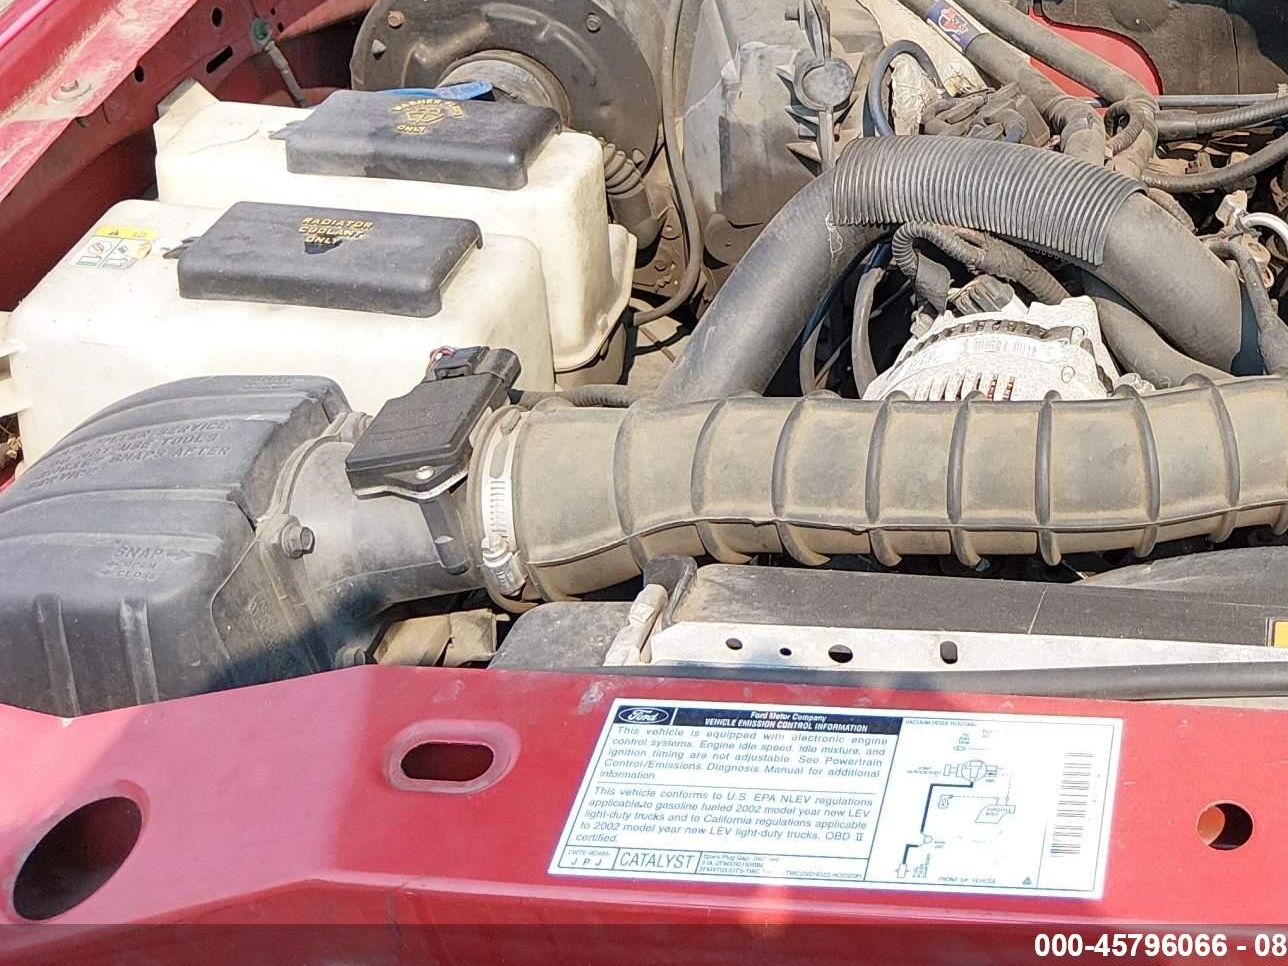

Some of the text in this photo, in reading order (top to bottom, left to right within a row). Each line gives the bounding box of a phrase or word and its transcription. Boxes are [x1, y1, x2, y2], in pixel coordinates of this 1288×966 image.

[302, 217, 373, 229] RADIATOR
[305, 236, 338, 245] ONLY
[172, 445, 231, 458] AFTER
[117, 545, 164, 558] SNAP
[628, 708, 659, 721] Ford
[750, 711, 827, 723] Ford Motor Company
[705, 717, 868, 732] VEHICLE EMISSION CONTROL INFORMATION
[618, 726, 640, 734] This
[646, 728, 684, 737] vehicle
[706, 730, 757, 741] equipped
[792, 734, 845, 743] electronic
[851, 737, 888, 746] engine
[613, 737, 647, 746] control
[700, 740, 735, 750] Engine
[738, 741, 757, 750] idle
[800, 744, 817, 753] idle
[866, 747, 885, 756] and
[608, 749, 883, 766] ignition timing are not See Powertrain
[604, 758, 881, 778] Control/Emissions Diagnosis Manual for additional
[595, 786, 873, 807] This vehicle conforms to EPA NLEV regulations
[589, 799, 870, 818] applicable gasoline fueled 2002 model year new LEV
[584, 809, 867, 830] light-duty trucks and to California regulations applicable
[575, 834, 618, 843] certified.
[580, 821, 851, 841] to 2002 model year new LEV light-duty OBD
[620, 852, 695, 868] CATALYST
